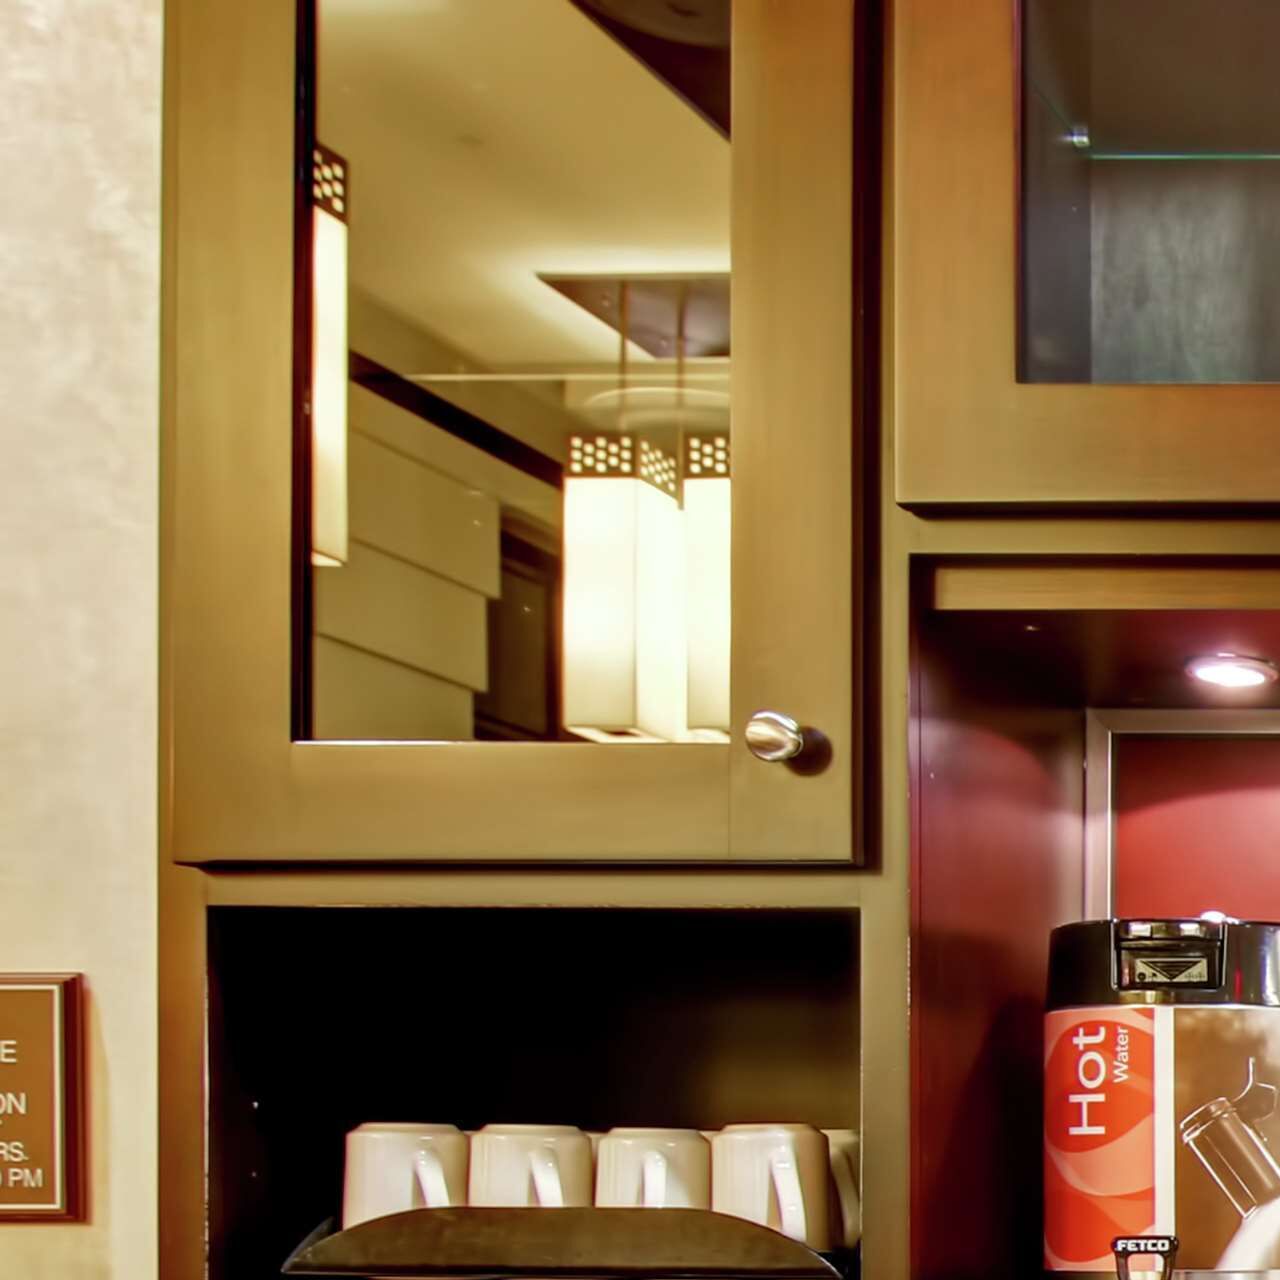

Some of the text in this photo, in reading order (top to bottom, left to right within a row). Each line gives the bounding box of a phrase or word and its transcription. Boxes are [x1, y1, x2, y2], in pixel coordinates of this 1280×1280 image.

[1113, 1025, 1128, 1083] Water
[1069, 1026, 1105, 1135] Hot
[8, 1168, 43, 1188] PM
[1116, 1239, 1170, 1252] FETCO
